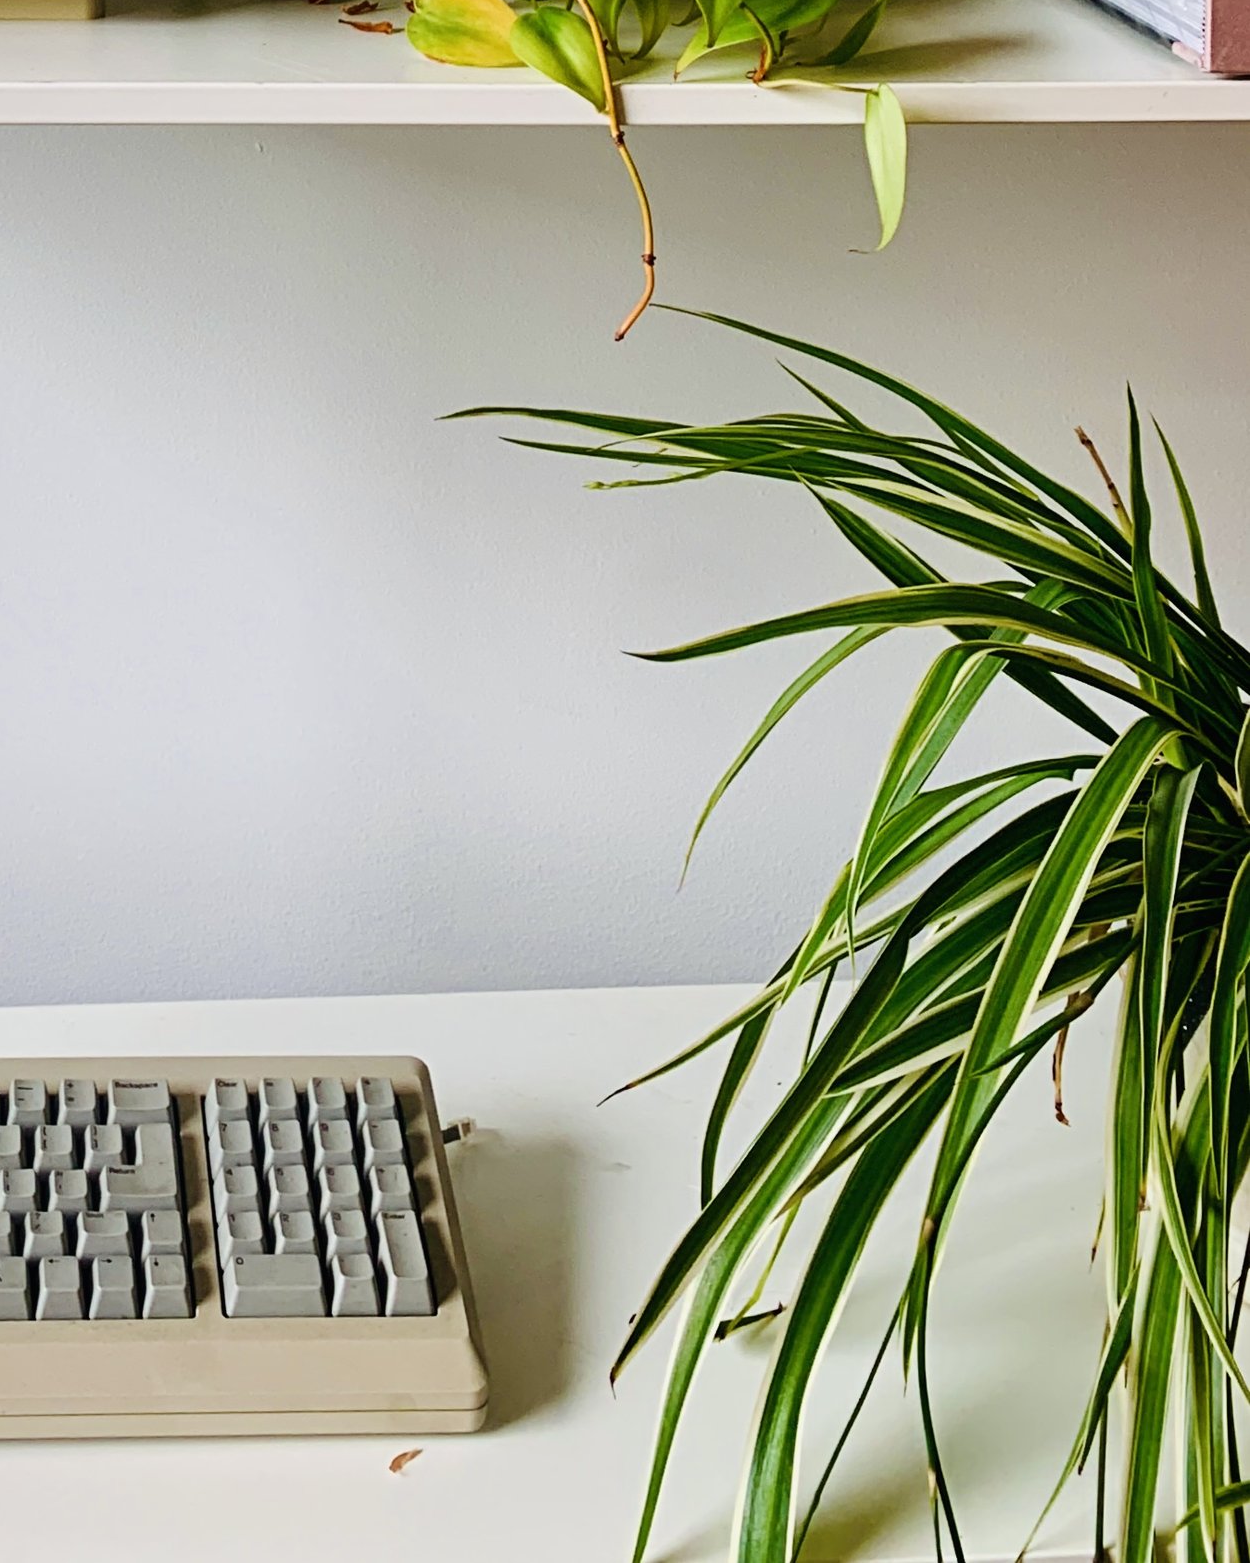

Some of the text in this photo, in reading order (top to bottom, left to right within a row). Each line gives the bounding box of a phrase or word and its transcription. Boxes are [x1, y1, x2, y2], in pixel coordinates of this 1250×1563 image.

[221, 1124, 227, 1132] 7
[321, 1124, 328, 1132] 9
[277, 1168, 283, 1176] 5
[230, 1214, 236, 1222] 1
